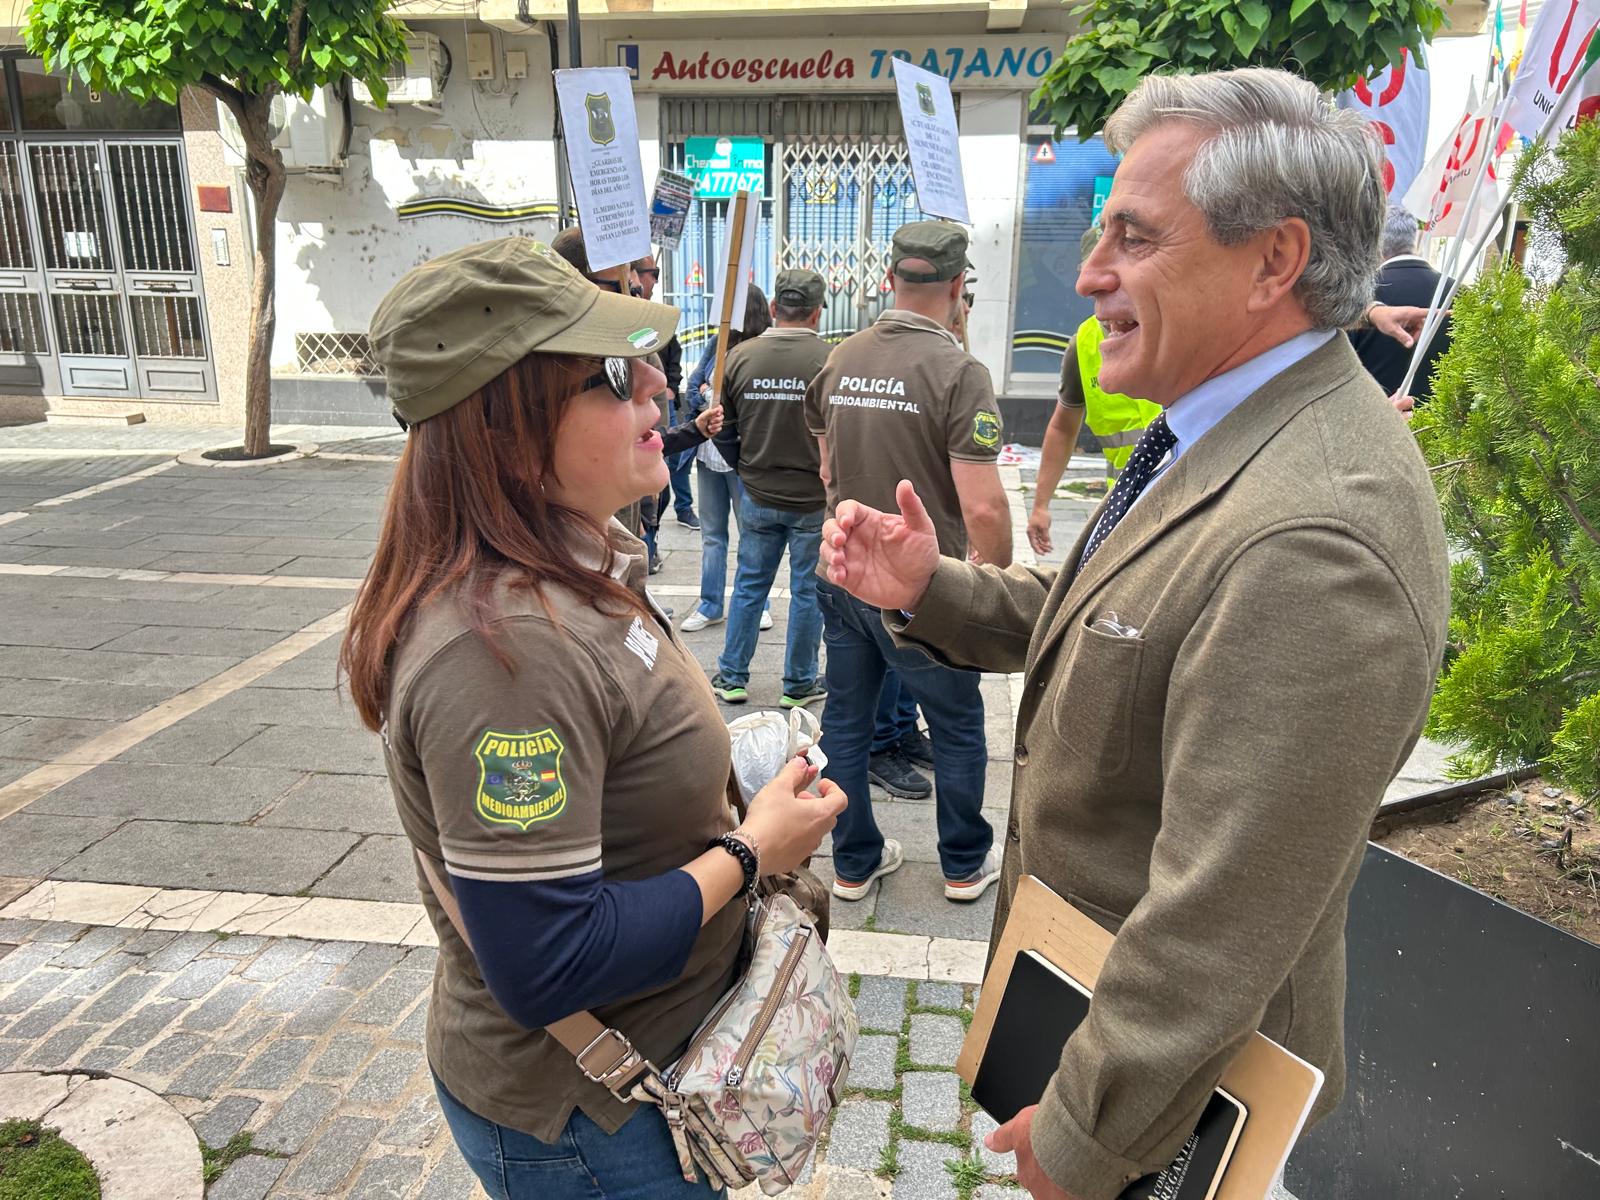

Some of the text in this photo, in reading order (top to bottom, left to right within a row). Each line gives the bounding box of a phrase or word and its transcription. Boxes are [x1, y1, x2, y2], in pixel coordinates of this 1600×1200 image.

[652, 50, 854, 83] Autoescuela
[753, 377, 806, 391] POLICÍA
[839, 376, 905, 396] POLICÍA
[743, 392, 806, 401] MEDIOAMBIENT
[828, 395, 920, 414] MEDIOAMBIENTAL
[483, 736, 558, 757] POLICÍA
[481, 787, 564, 819] MEDIOAMBIENTAL
